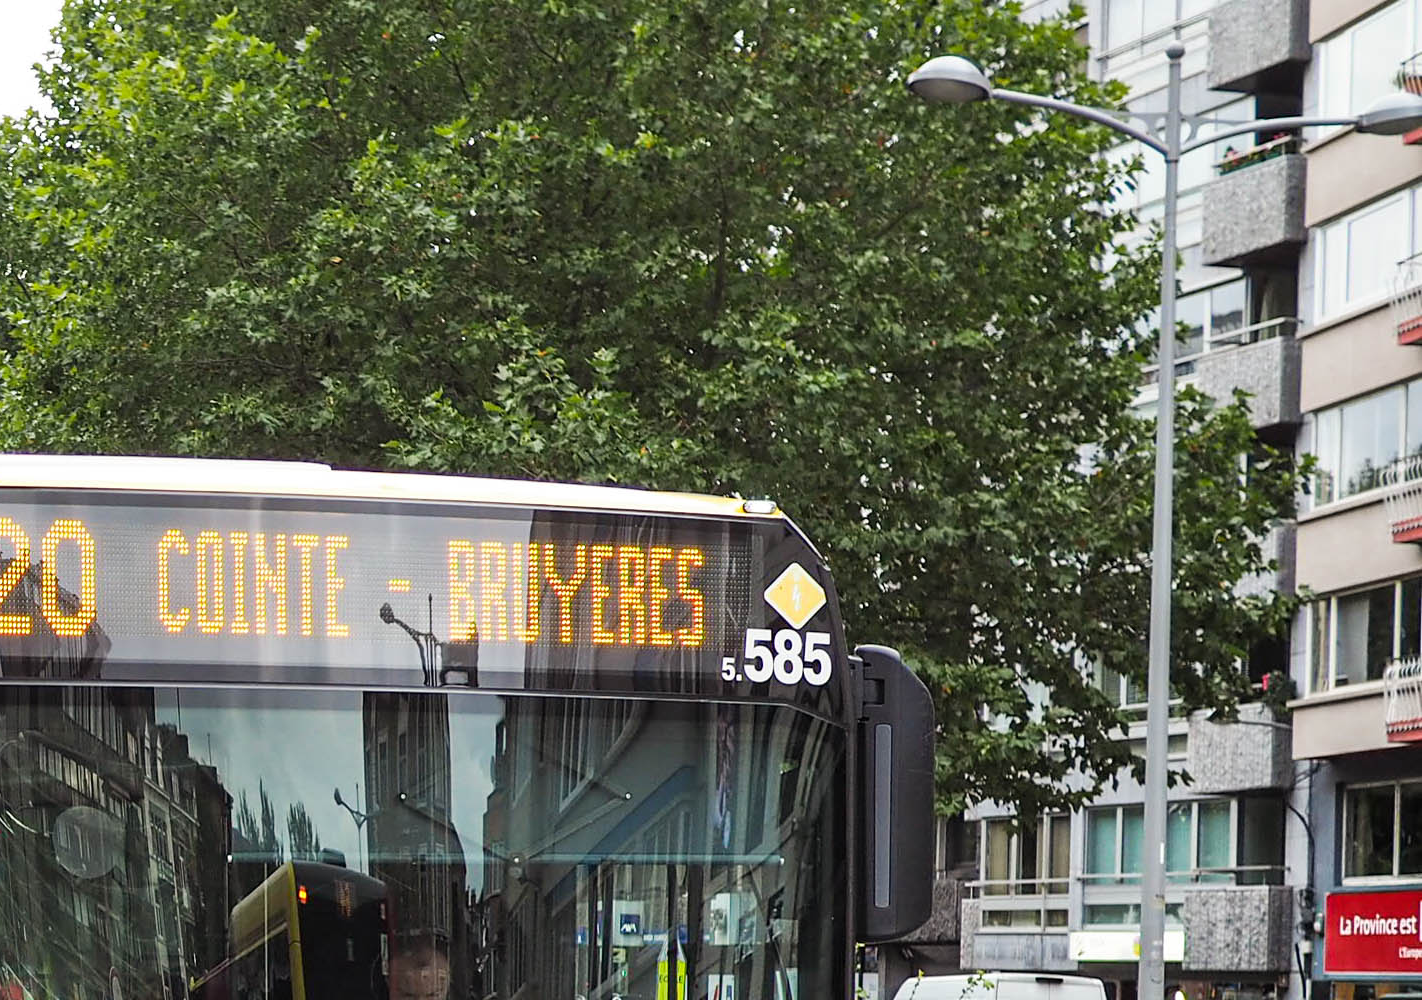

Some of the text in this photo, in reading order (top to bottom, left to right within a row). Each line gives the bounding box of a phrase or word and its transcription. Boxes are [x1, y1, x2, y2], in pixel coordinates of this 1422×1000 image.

[157, 528, 351, 637] COINTE
[447, 538, 706, 648] BRUYERES
[721, 628, 833, 687] 5.585
[1339, 913, 1418, 936] La Province est
